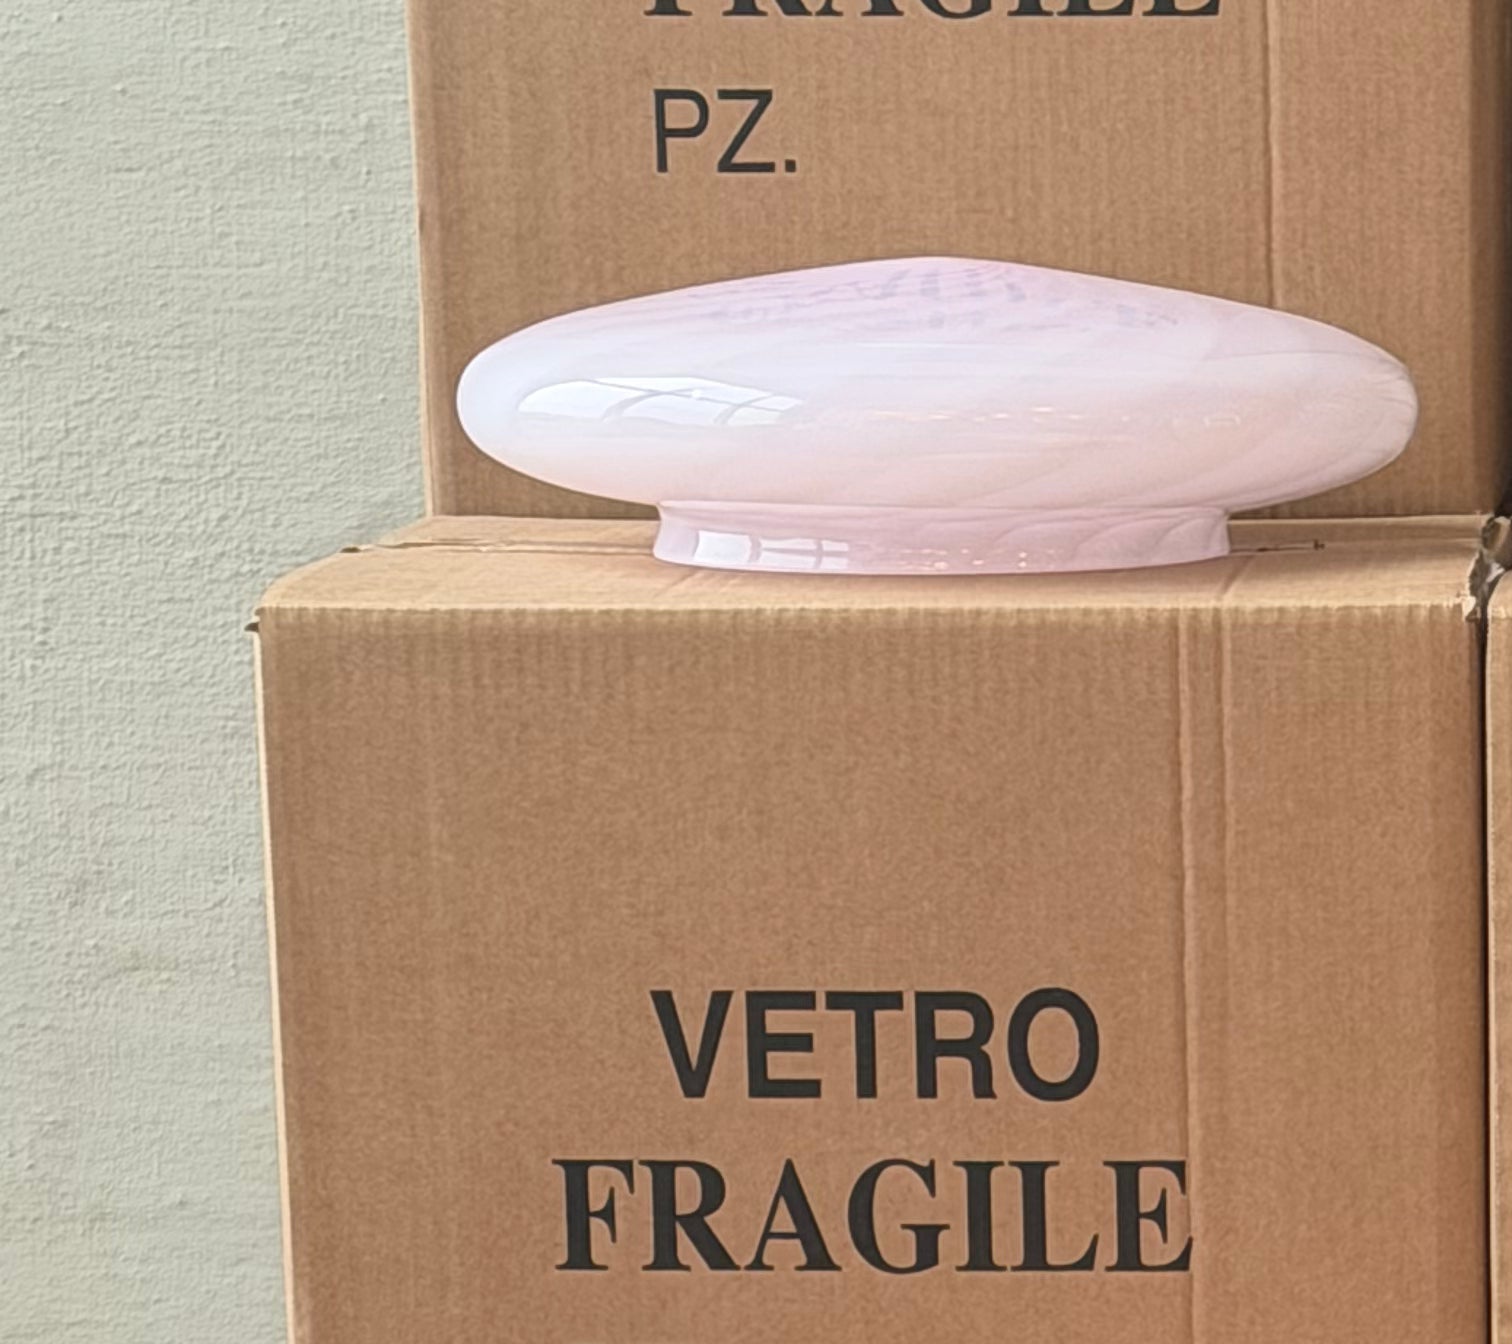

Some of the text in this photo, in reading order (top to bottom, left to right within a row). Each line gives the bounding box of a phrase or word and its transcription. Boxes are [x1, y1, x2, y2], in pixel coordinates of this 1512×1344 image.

[653, 88, 797, 173] PZ.
[649, 987, 1100, 1102] VETRO
[551, 1158, 1194, 1275] FRAGILE
